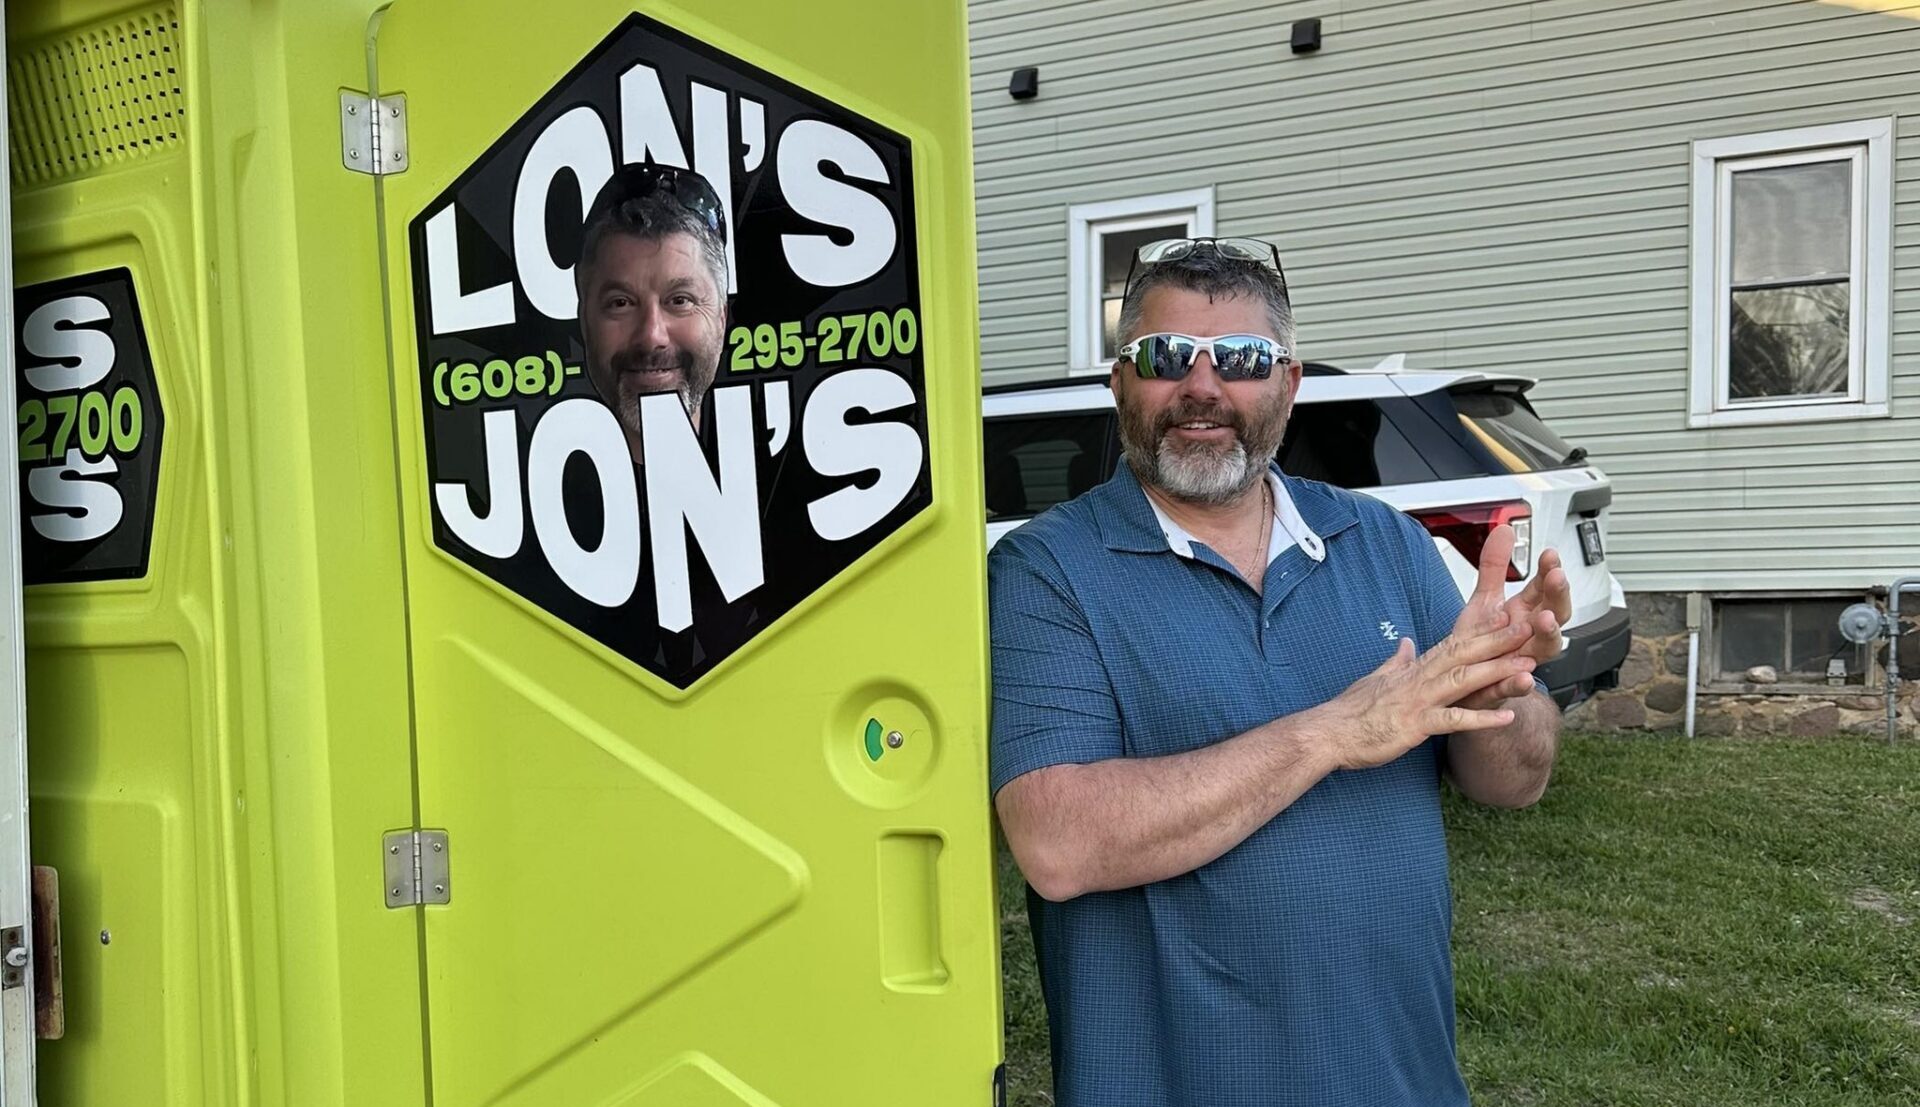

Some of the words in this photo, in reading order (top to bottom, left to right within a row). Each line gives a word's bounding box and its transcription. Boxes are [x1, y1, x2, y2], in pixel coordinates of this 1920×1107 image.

[425, 64, 897, 335] LON'S
[729, 309, 917, 372] 295-2700
[434, 367, 923, 633] JON'S
